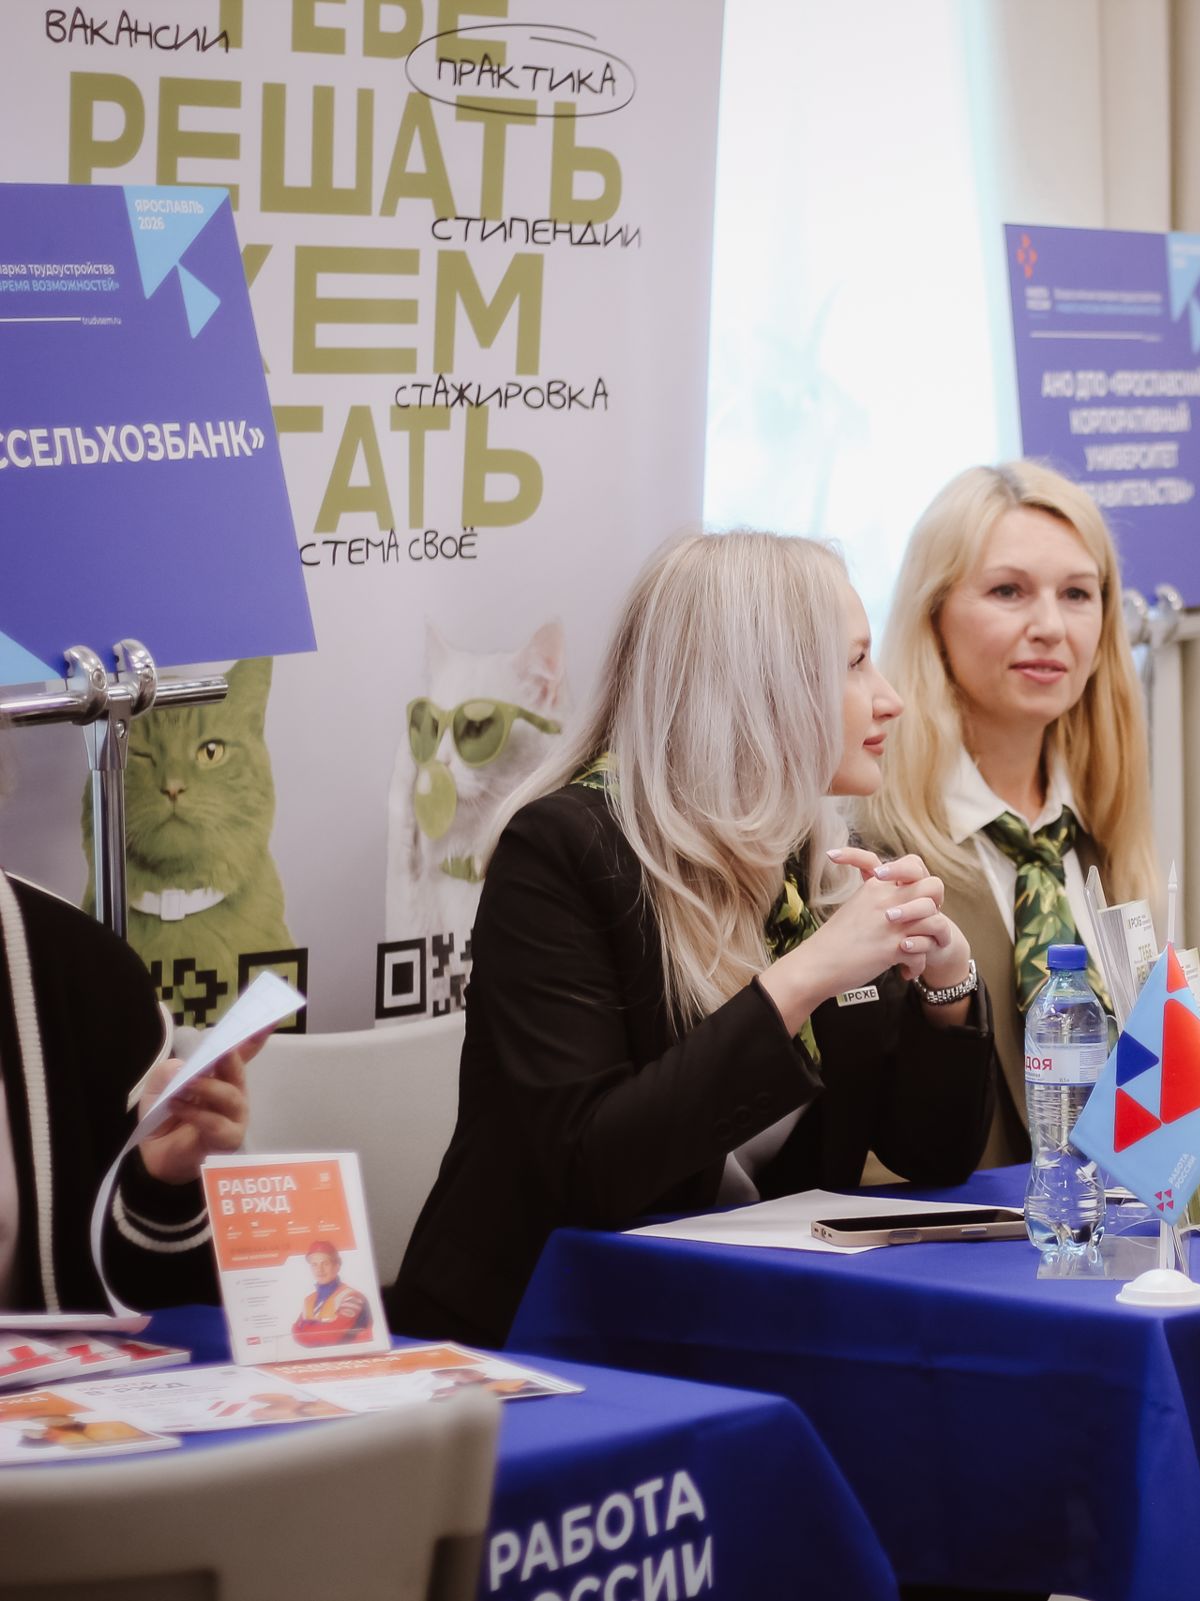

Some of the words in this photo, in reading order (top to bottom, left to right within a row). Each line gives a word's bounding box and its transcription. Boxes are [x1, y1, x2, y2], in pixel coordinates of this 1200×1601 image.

[45, 8, 229, 53] ВАКАНСИИ
[438, 54, 615, 96] ПРАКТИКА
[68, 71, 624, 226] РЕШАТЬ
[134, 199, 205, 215] ЯРОСЛАВЛЬ
[138, 216, 166, 231] 2026
[431, 216, 641, 249] СТИПЕНДИИ
[0, 264, 27, 278] арка
[28, 261, 116, 278] трудоустройства
[32, 277, 120, 292] ВОЗМОЖНОСТЕЙ»
[394, 374, 609, 411] СТАЖИРОВКА
[299, 528, 399, 566] СТЕМА
[408, 526, 479, 562] СВОЁ
[217, 1175, 297, 1197] РАБОТА
[221, 1199, 236, 1216] В
[241, 1195, 292, 1215] РЖД
[489, 1470, 706, 1593] РАБОТА
